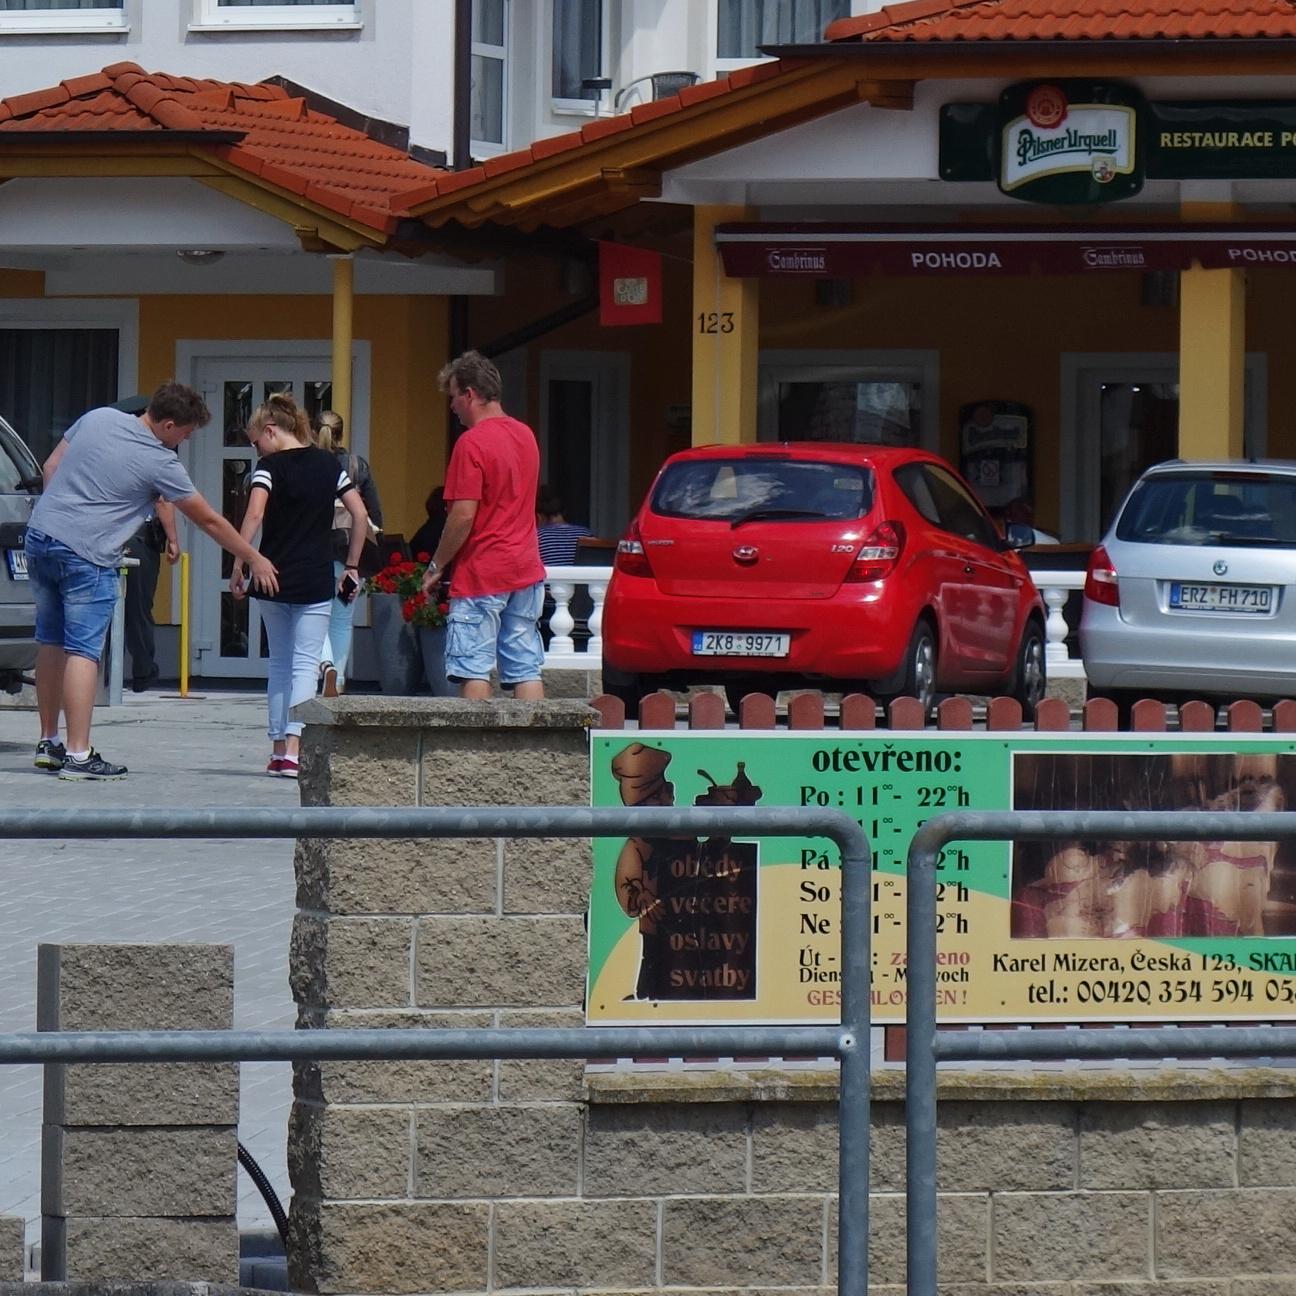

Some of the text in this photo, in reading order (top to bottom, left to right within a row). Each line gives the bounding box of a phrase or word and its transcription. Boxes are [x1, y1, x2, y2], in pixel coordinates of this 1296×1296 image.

[1017, 128, 1117, 166] Pilsner Urquell
[1160, 131, 1274, 147] RESTAURACE
[911, 252, 1002, 268] POHODA
[698, 312, 734, 334] 123
[1181, 587, 1269, 606] ERZ FH 710
[706, 634, 782, 651] 2K8 9971
[812, 743, 962, 773] otevřeno:
[800, 785, 830, 807] Po
[801, 849, 830, 870] Pá
[800, 880, 831, 903] So
[800, 913, 831, 934] Ne
[669, 927, 750, 954] oslavy
[799, 945, 821, 967] Út
[993, 953, 1047, 972] Karel
[1054, 953, 1125, 973] Mizera,
[1131, 949, 1192, 972] Česká
[1201, 953, 1242, 973] 123,
[669, 963, 751, 991] svatby
[1029, 982, 1068, 1004] tel.:
[1076, 980, 1152, 1003] 00420
[1159, 980, 1203, 1003] 354
[1211, 980, 1255, 1002] 594
